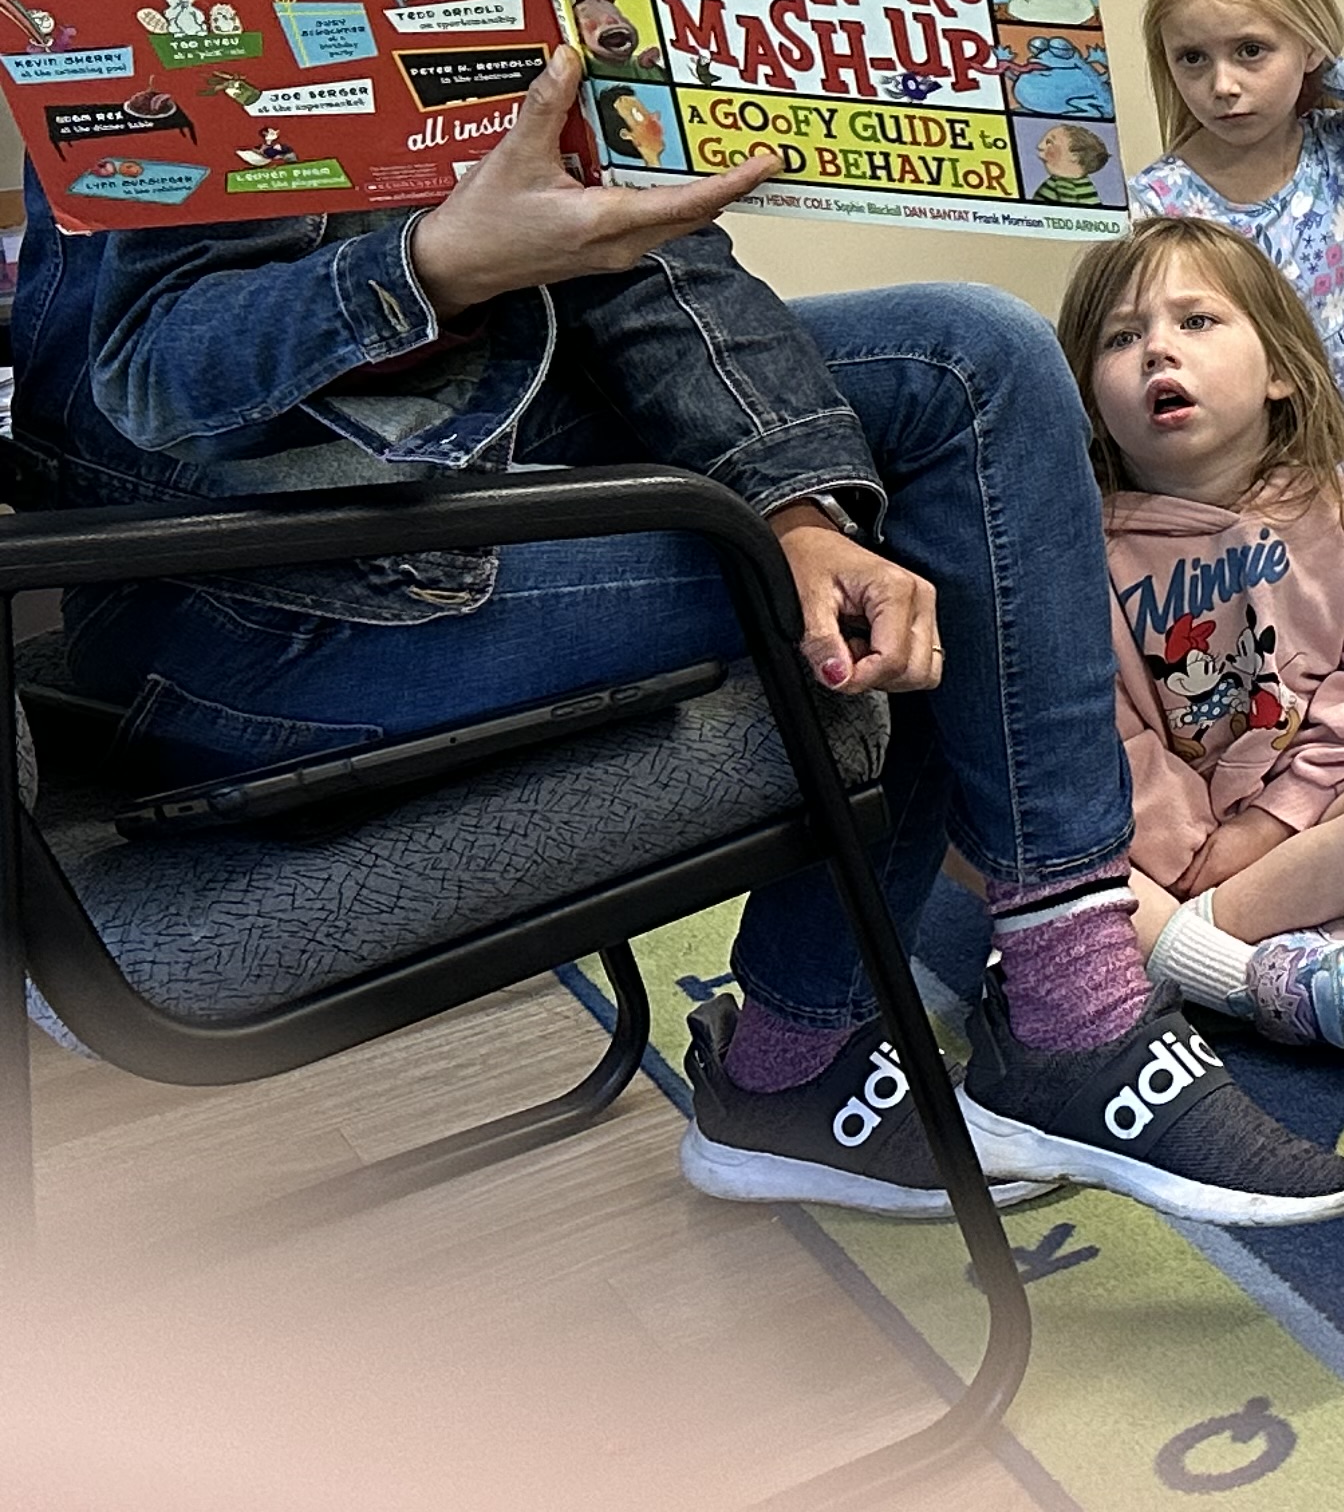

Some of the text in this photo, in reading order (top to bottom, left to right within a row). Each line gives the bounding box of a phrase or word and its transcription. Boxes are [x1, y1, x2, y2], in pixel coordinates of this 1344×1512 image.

[407, 102, 521, 151] all insid
[688, 105, 707, 127] A
[848, 110, 974, 152] GUIDE
[979, 129, 1008, 152] to
[766, 194, 801, 209] HENRY
[803, 197, 832, 210] COLE
[904, 205, 929, 219] DAN
[929, 206, 971, 222] SANTAT
[973, 211, 1000, 226] Frank
[1045, 216, 1074, 232] TEDD
[1074, 218, 1121, 235] ARNOLD
[1121, 528, 1290, 651] Minnie
[1154, 1396, 1298, 1495] Q
